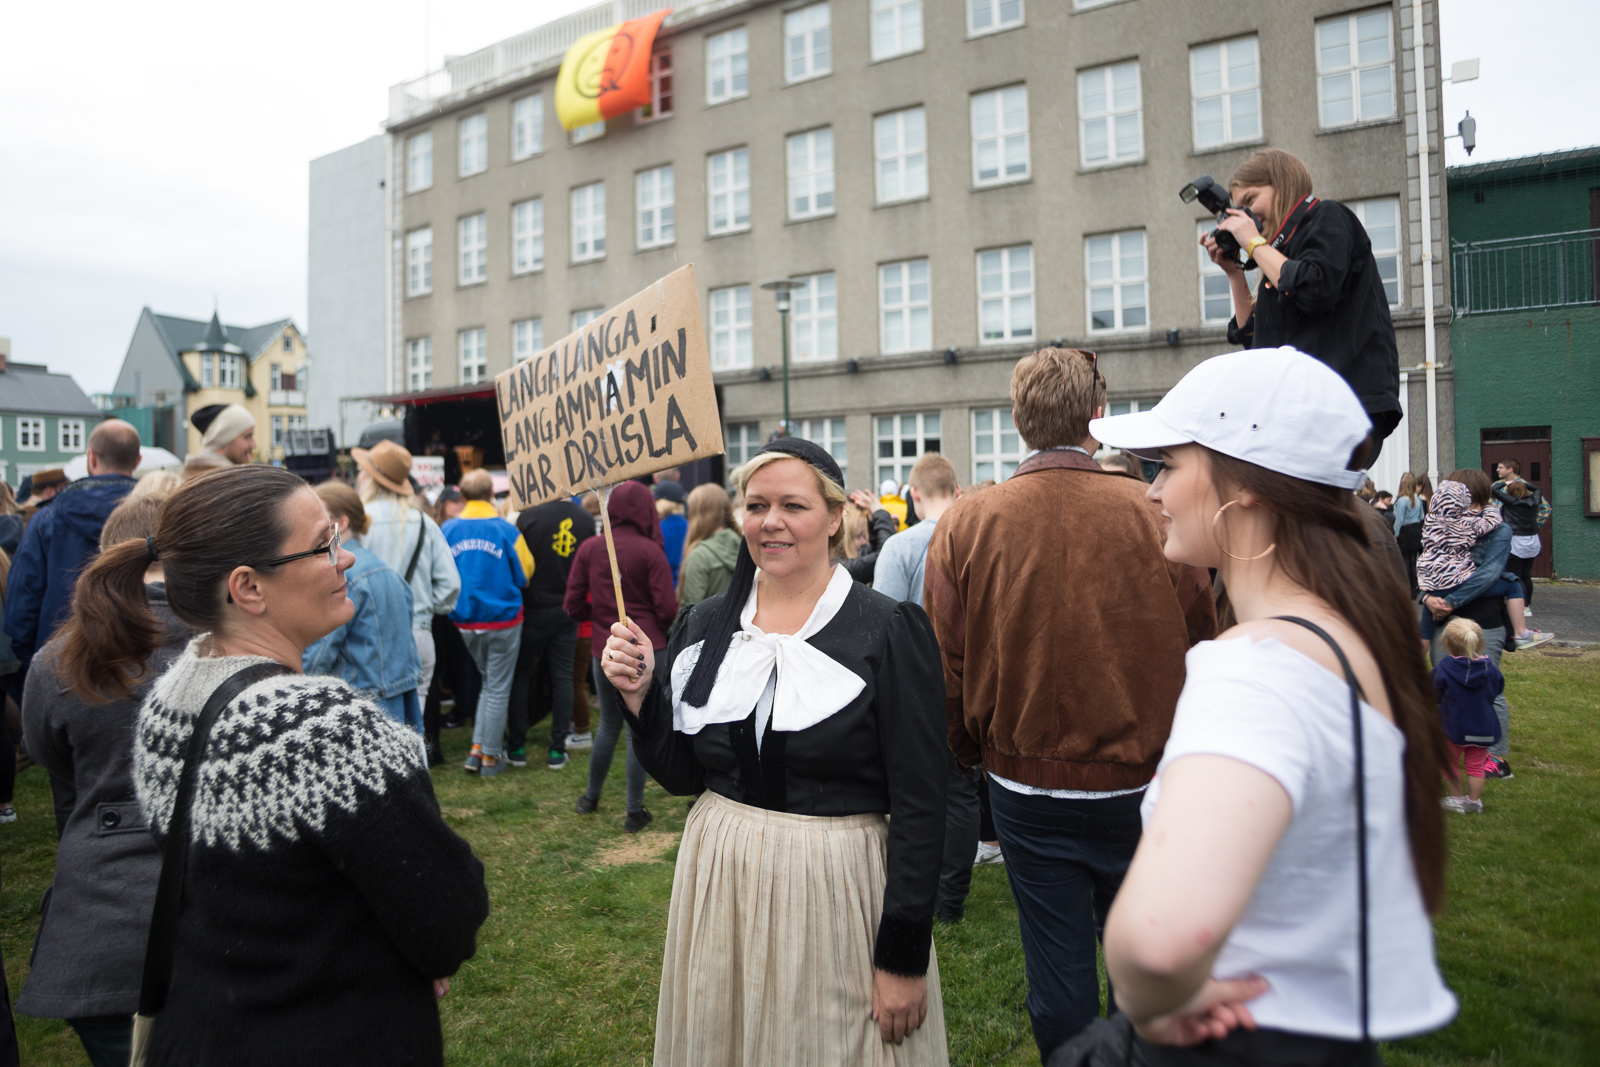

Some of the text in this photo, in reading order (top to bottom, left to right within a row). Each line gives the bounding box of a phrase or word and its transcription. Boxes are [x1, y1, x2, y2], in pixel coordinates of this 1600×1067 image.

[504, 370, 624, 464] LANGAMMA
[511, 394, 698, 506] VAR DRUSLA
[451, 538, 503, 559] ENEZUELA
